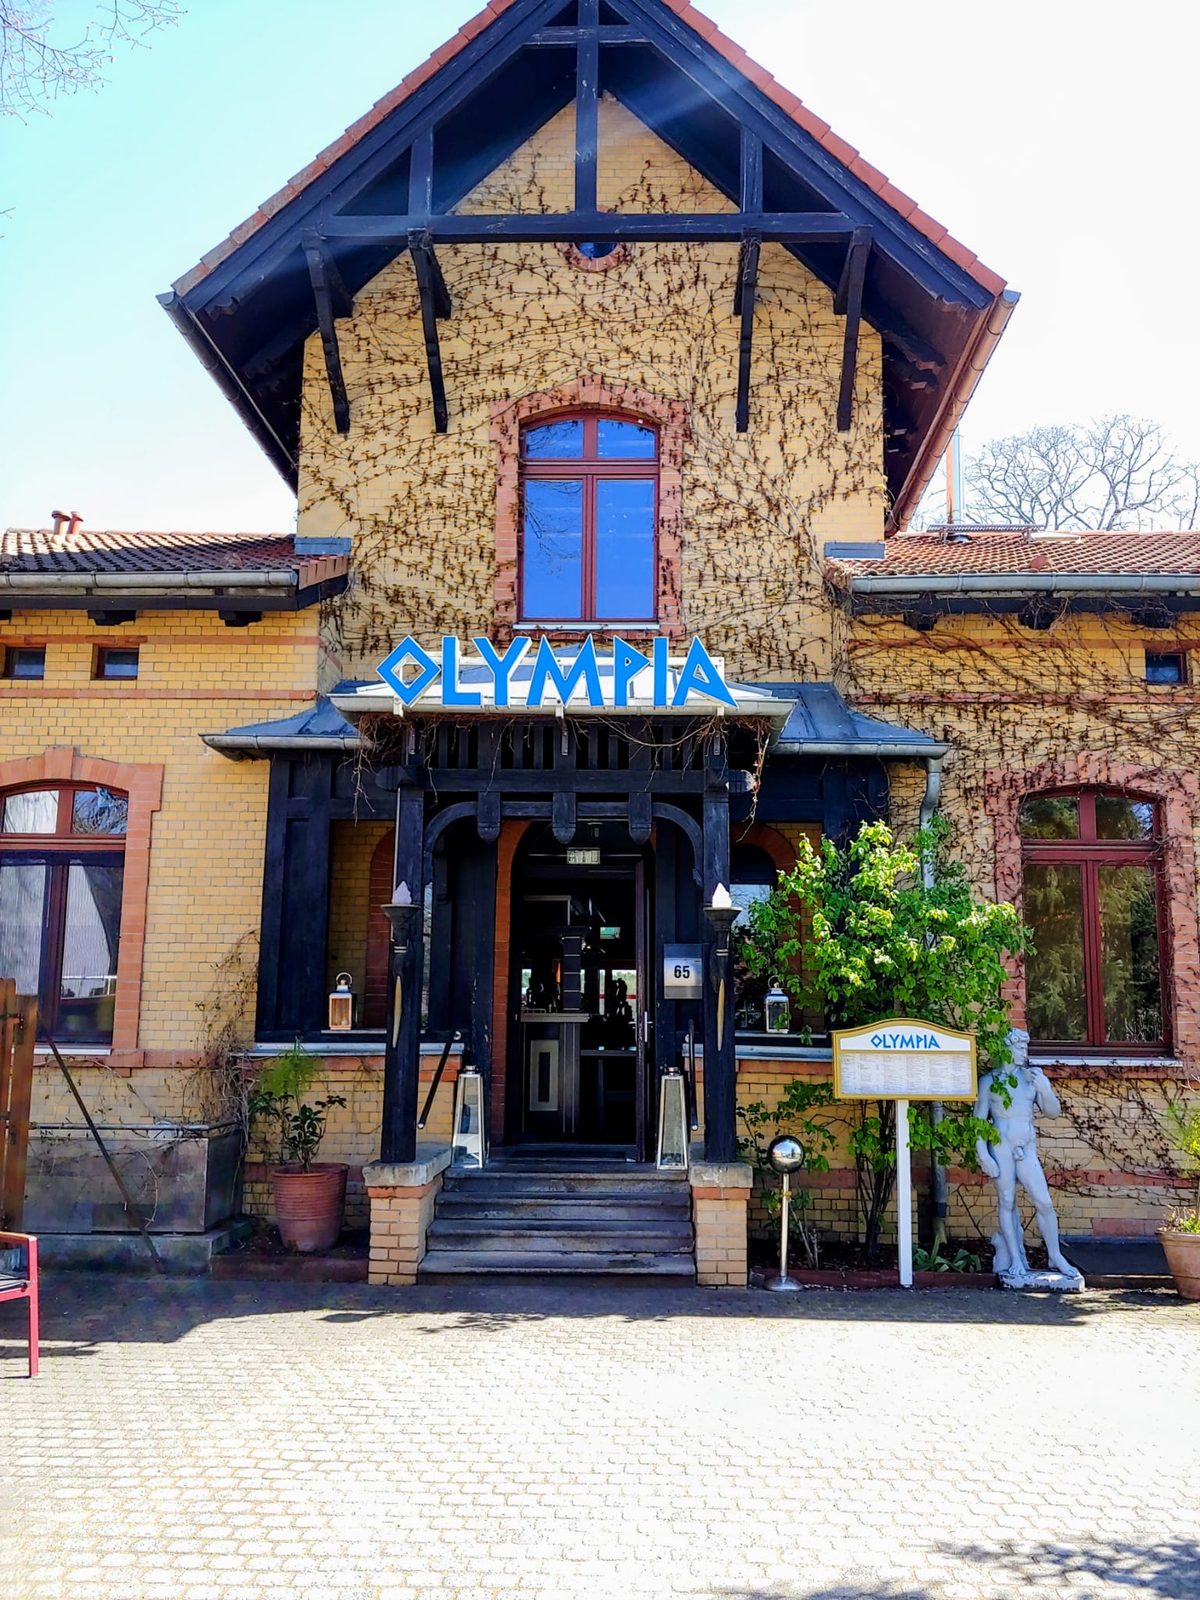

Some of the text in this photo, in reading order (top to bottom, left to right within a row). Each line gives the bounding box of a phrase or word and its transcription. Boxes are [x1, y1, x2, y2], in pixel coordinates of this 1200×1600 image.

[376, 634, 739, 709] OLYMPIA
[674, 964, 690, 979] 65
[870, 1034, 941, 1049] OLYMPIA
